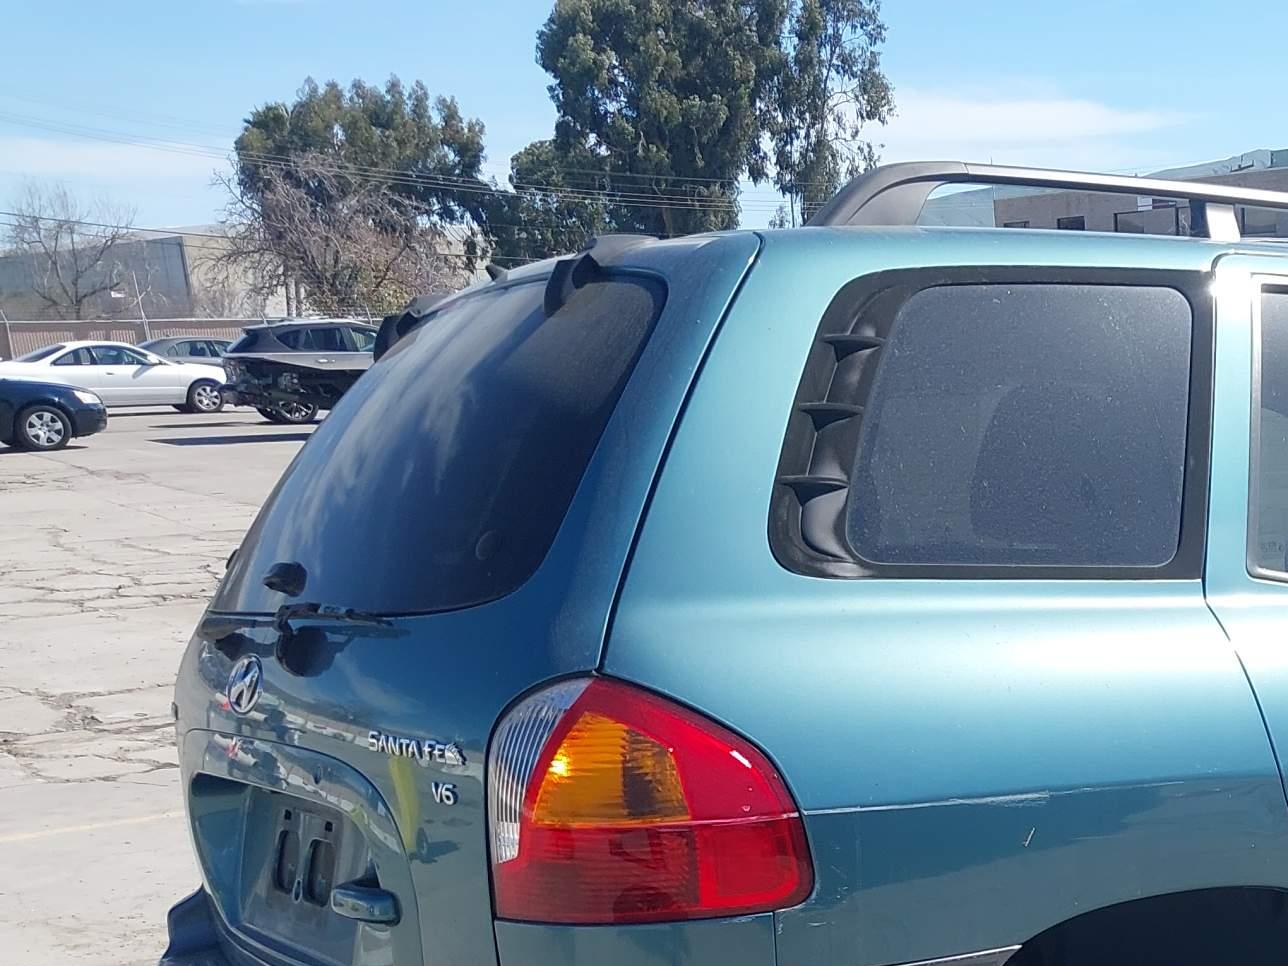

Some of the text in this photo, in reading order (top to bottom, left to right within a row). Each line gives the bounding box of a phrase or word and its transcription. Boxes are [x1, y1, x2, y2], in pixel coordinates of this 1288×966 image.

[367, 730, 446, 763] SANTA FE
[431, 781, 455, 806] V6
